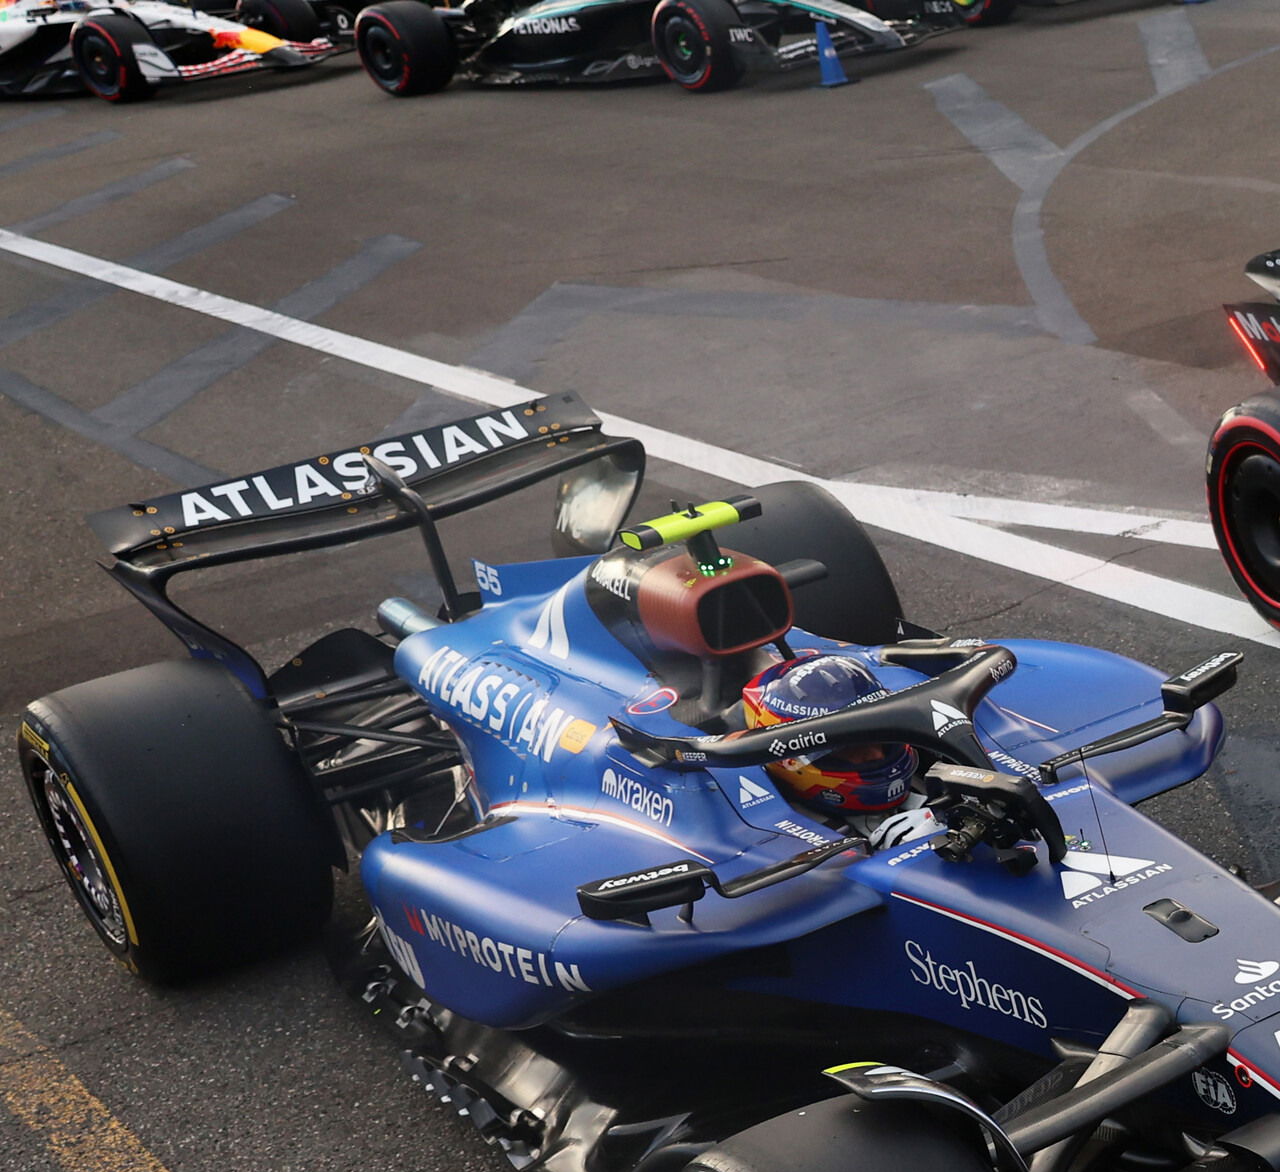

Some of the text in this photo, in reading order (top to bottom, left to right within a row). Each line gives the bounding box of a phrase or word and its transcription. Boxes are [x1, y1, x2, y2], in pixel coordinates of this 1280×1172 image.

[729, 28, 753, 43] IWC
[180, 410, 530, 527] ATLASSIAN
[474, 559, 503, 596] 55
[1180, 652, 1237, 682] betway
[417, 646, 575, 762] ATLASSIAN
[770, 699, 829, 717] ATLASSIAN
[682, 750, 706, 763] KEEPER
[790, 731, 826, 751] airia
[741, 794, 776, 810] ATLASSIAN
[598, 863, 689, 892] betway
[1071, 863, 1173, 909] ATLASSIAN
[420, 908, 592, 992] MYPROTEIN
[904, 940, 1048, 1030] Stephens
[1195, 1072, 1233, 1107] FIA
